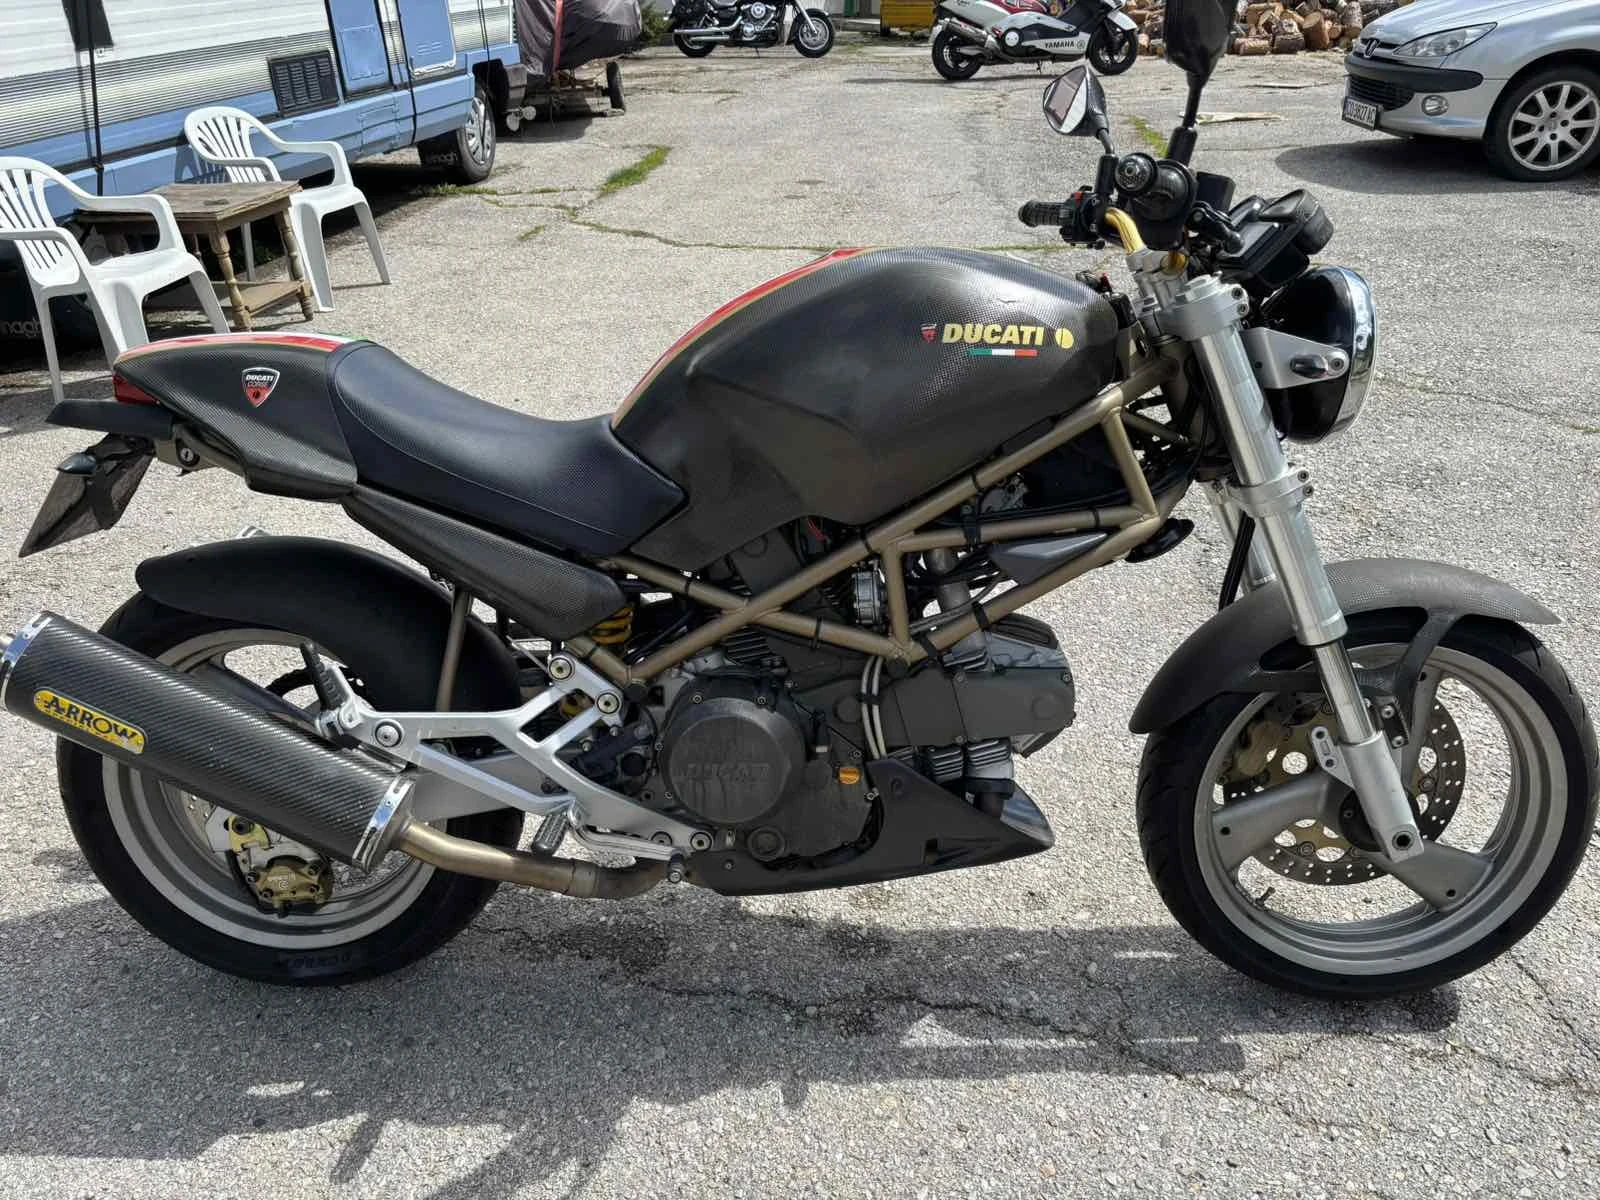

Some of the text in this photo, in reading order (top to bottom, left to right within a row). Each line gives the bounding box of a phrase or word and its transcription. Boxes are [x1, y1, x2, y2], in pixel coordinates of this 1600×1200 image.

[1045, 40, 1075, 48] YAMAHA
[942, 323, 1045, 346] DUCATI
[43, 695, 138, 740] ARROW
